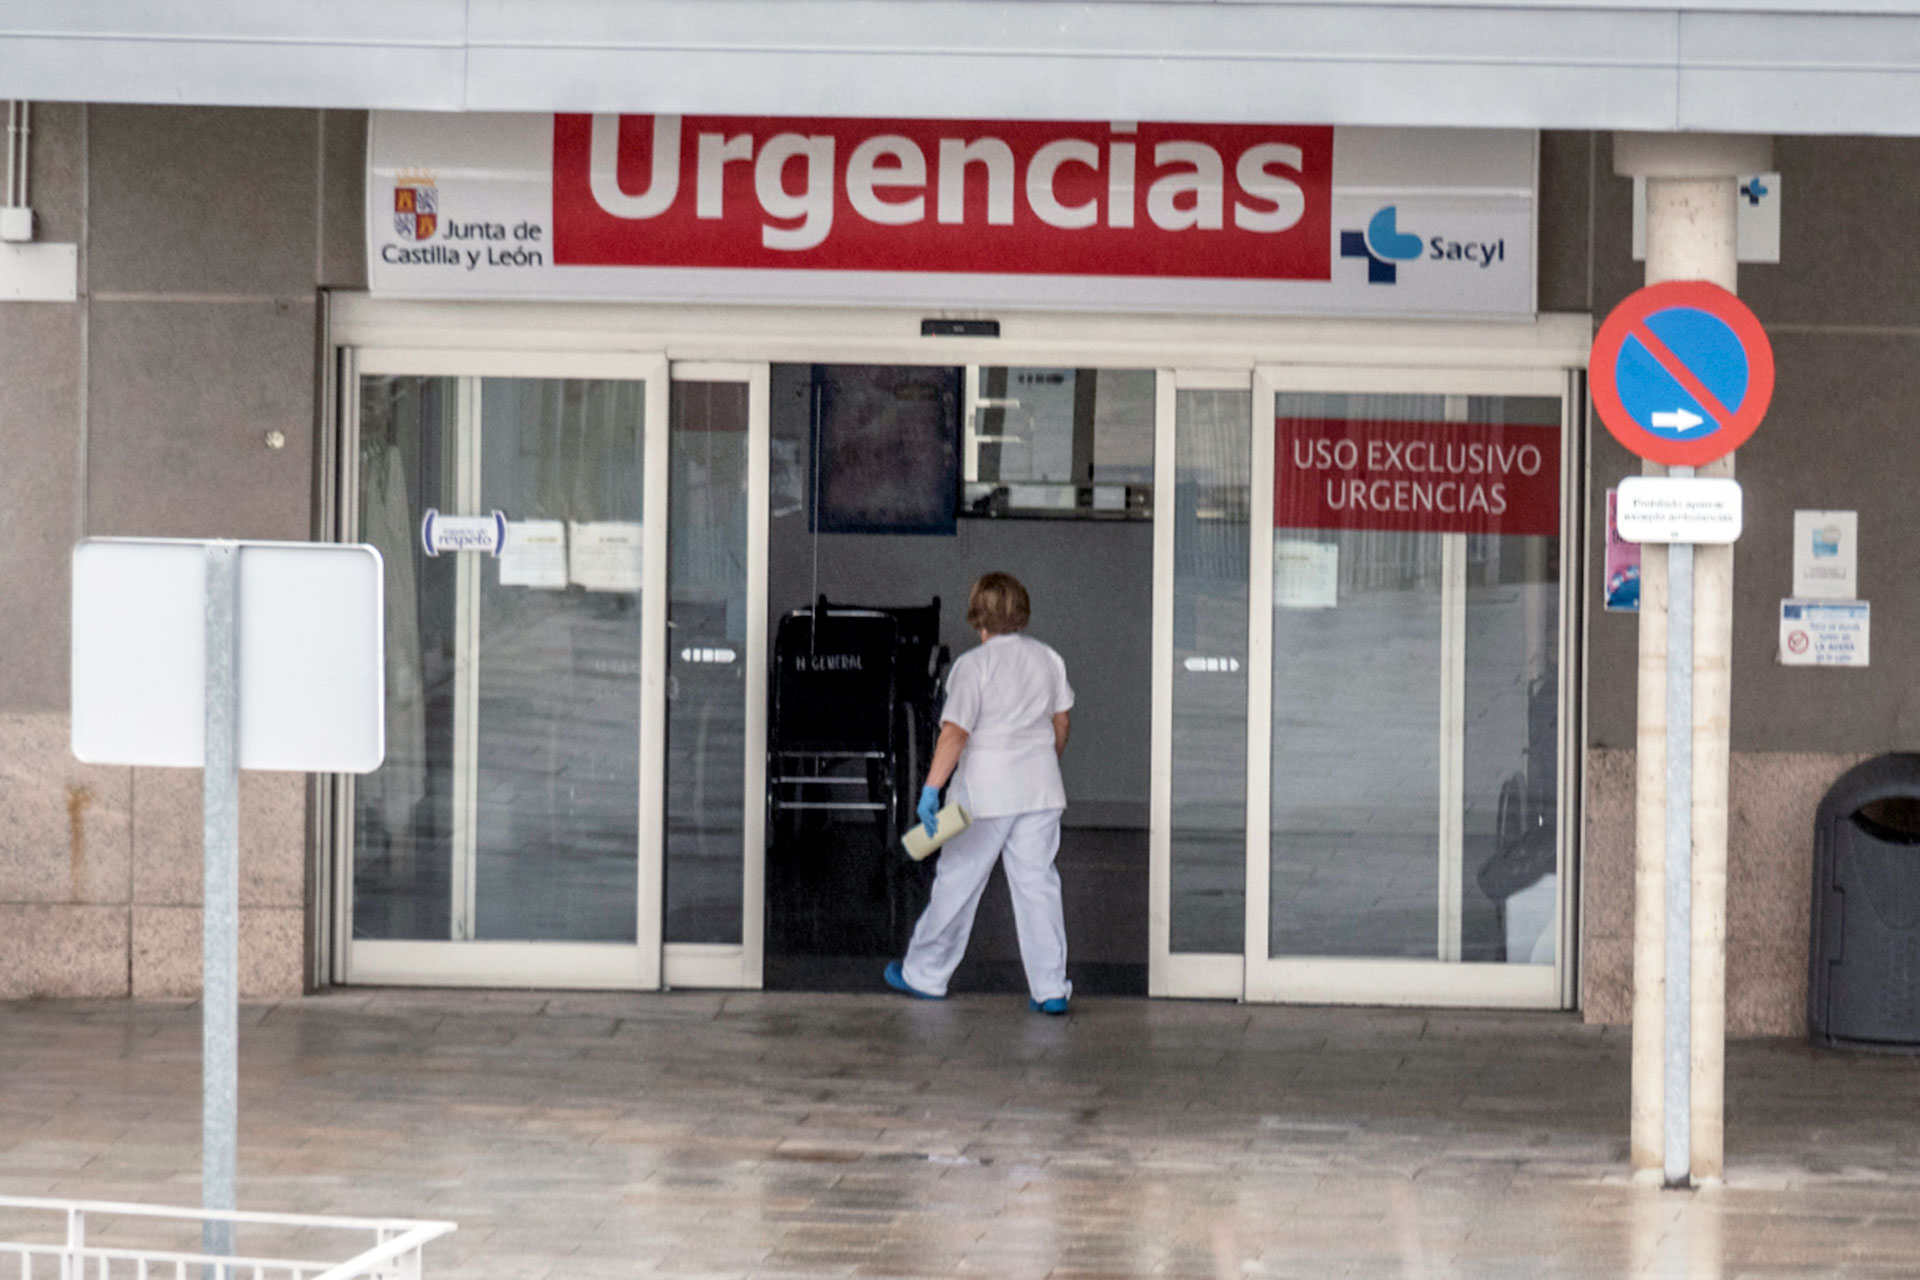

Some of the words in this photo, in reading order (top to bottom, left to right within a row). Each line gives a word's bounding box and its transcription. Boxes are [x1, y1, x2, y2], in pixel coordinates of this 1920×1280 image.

[589, 113, 1306, 252] Urgencias
[441, 219, 506, 242] Junta
[512, 220, 542, 242] de
[381, 244, 461, 267] Castilla
[466, 250, 479, 270] y
[486, 246, 543, 267] León
[1429, 236, 1505, 267] Sacyl
[1293, 438, 1359, 471] USO
[1367, 440, 1542, 476] EXCLUSIVO
[1326, 477, 1508, 515] URGENCIAS
[438, 533, 492, 550] respeto
[811, 654, 864, 671] GENERAL
